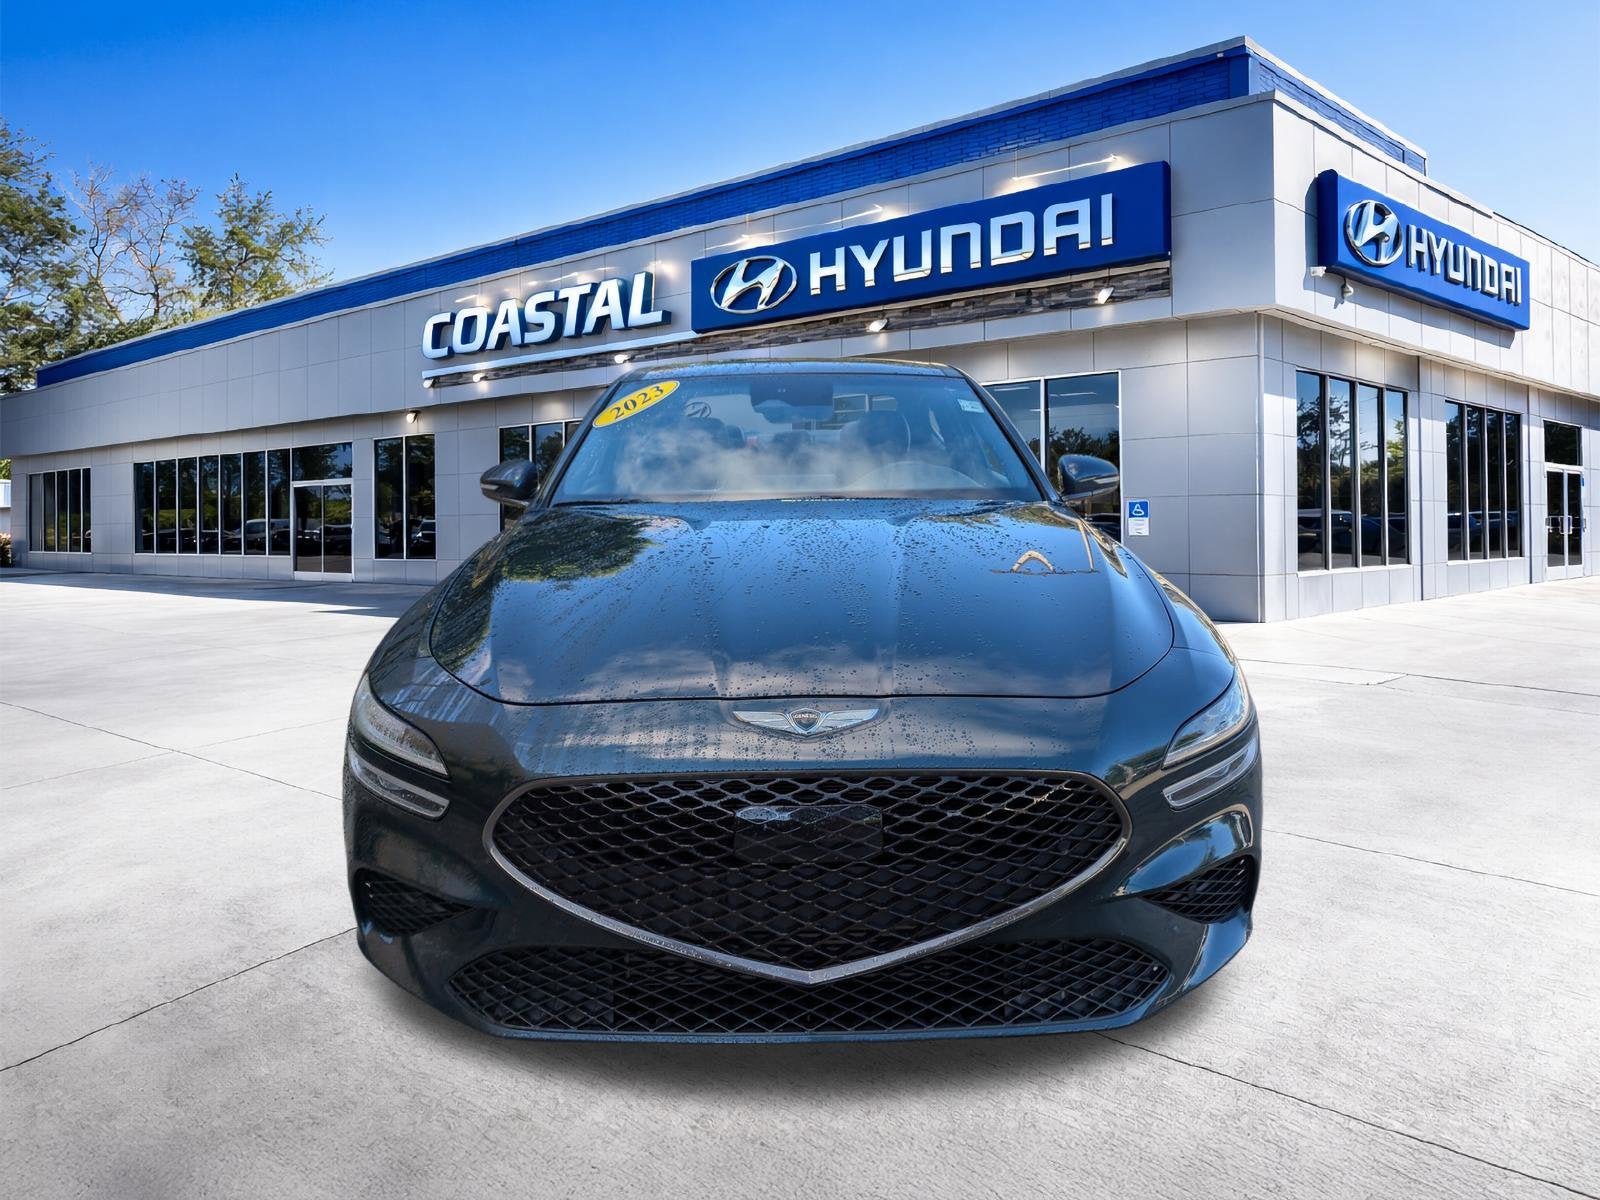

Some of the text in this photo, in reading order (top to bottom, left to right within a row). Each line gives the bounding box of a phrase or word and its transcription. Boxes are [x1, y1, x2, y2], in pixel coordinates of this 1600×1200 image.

[809, 193, 1114, 295] HYUNDAI
[1406, 224, 1522, 305] HYUNDAI
[422, 271, 668, 360] COASTAL
[610, 385, 664, 419] 2023
